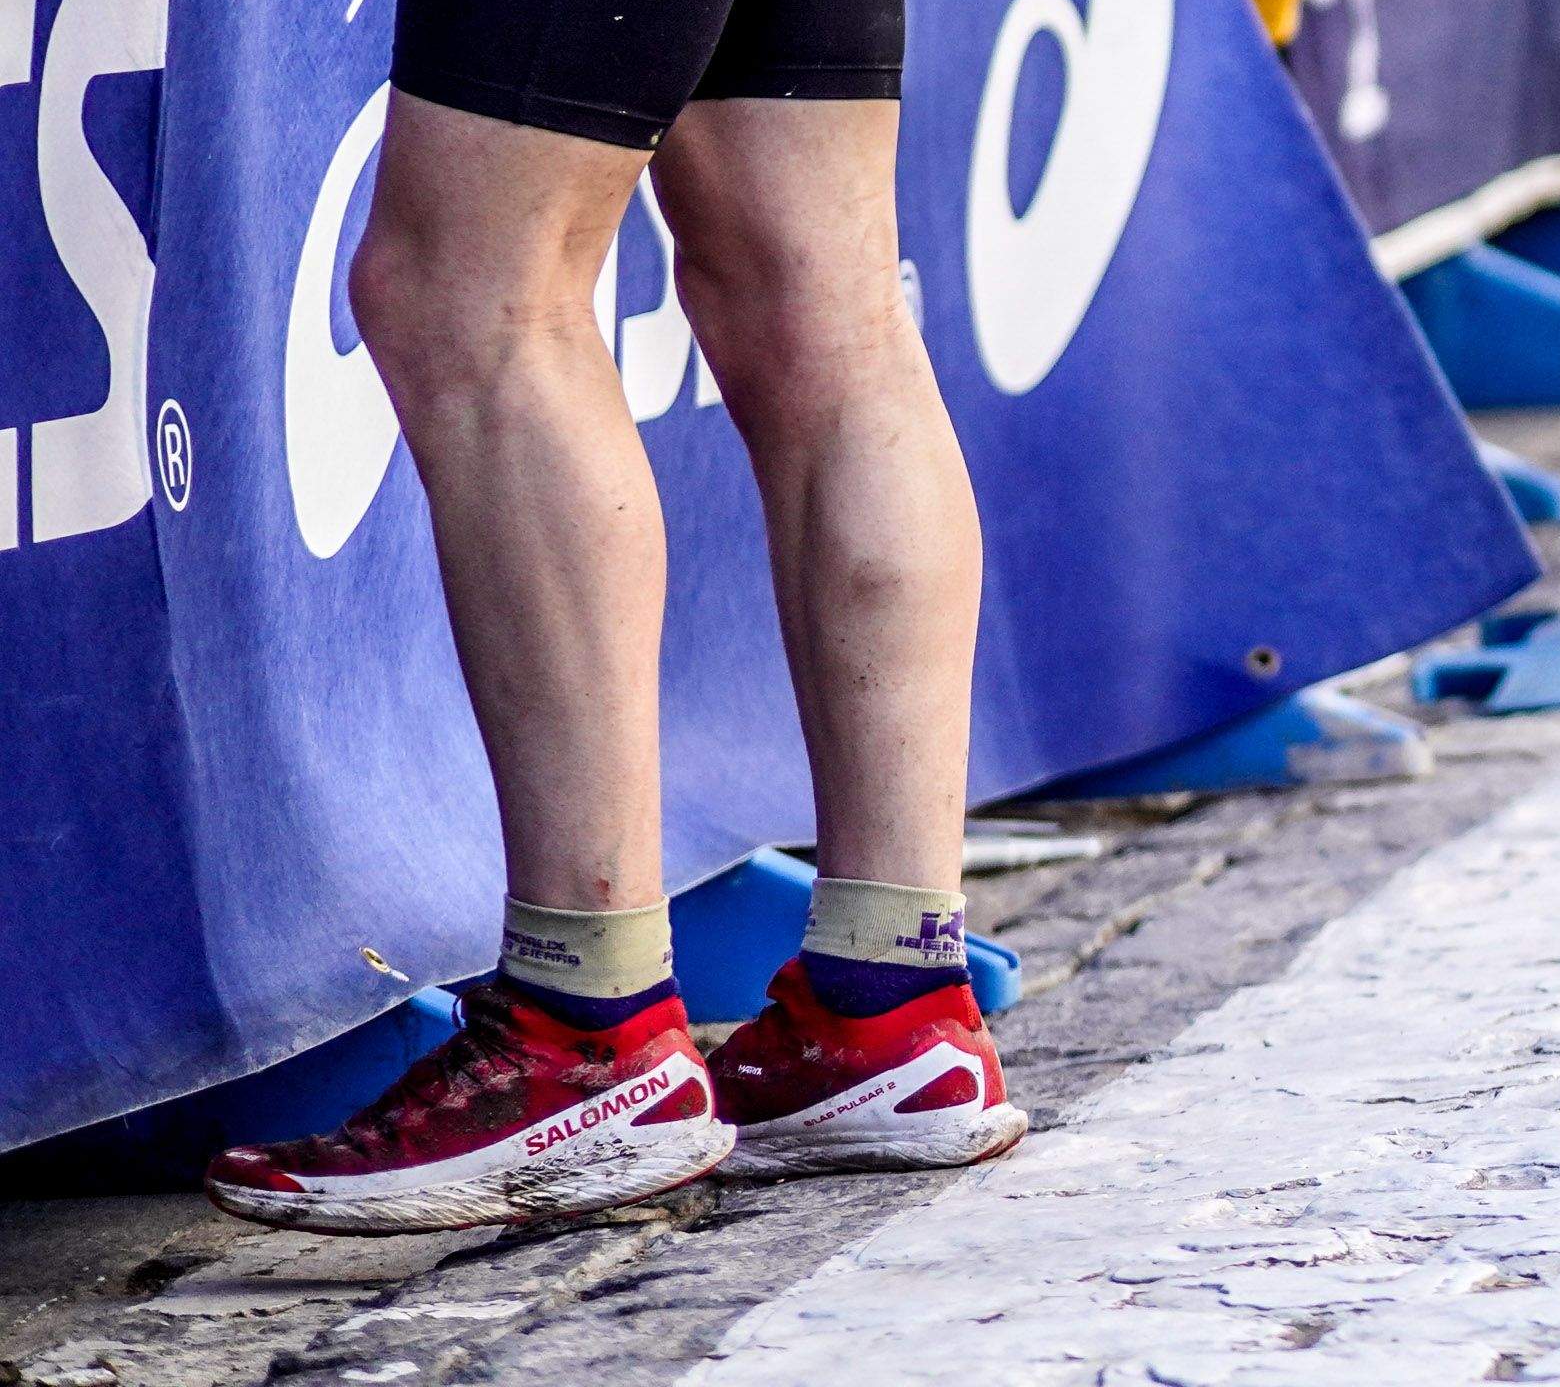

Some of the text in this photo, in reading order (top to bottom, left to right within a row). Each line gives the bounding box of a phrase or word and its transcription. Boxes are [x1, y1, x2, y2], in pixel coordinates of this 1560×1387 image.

[525, 1070, 670, 1157] SALOMON
[837, 1087, 885, 1115] PULSAR
[885, 1081, 898, 1091] 2
